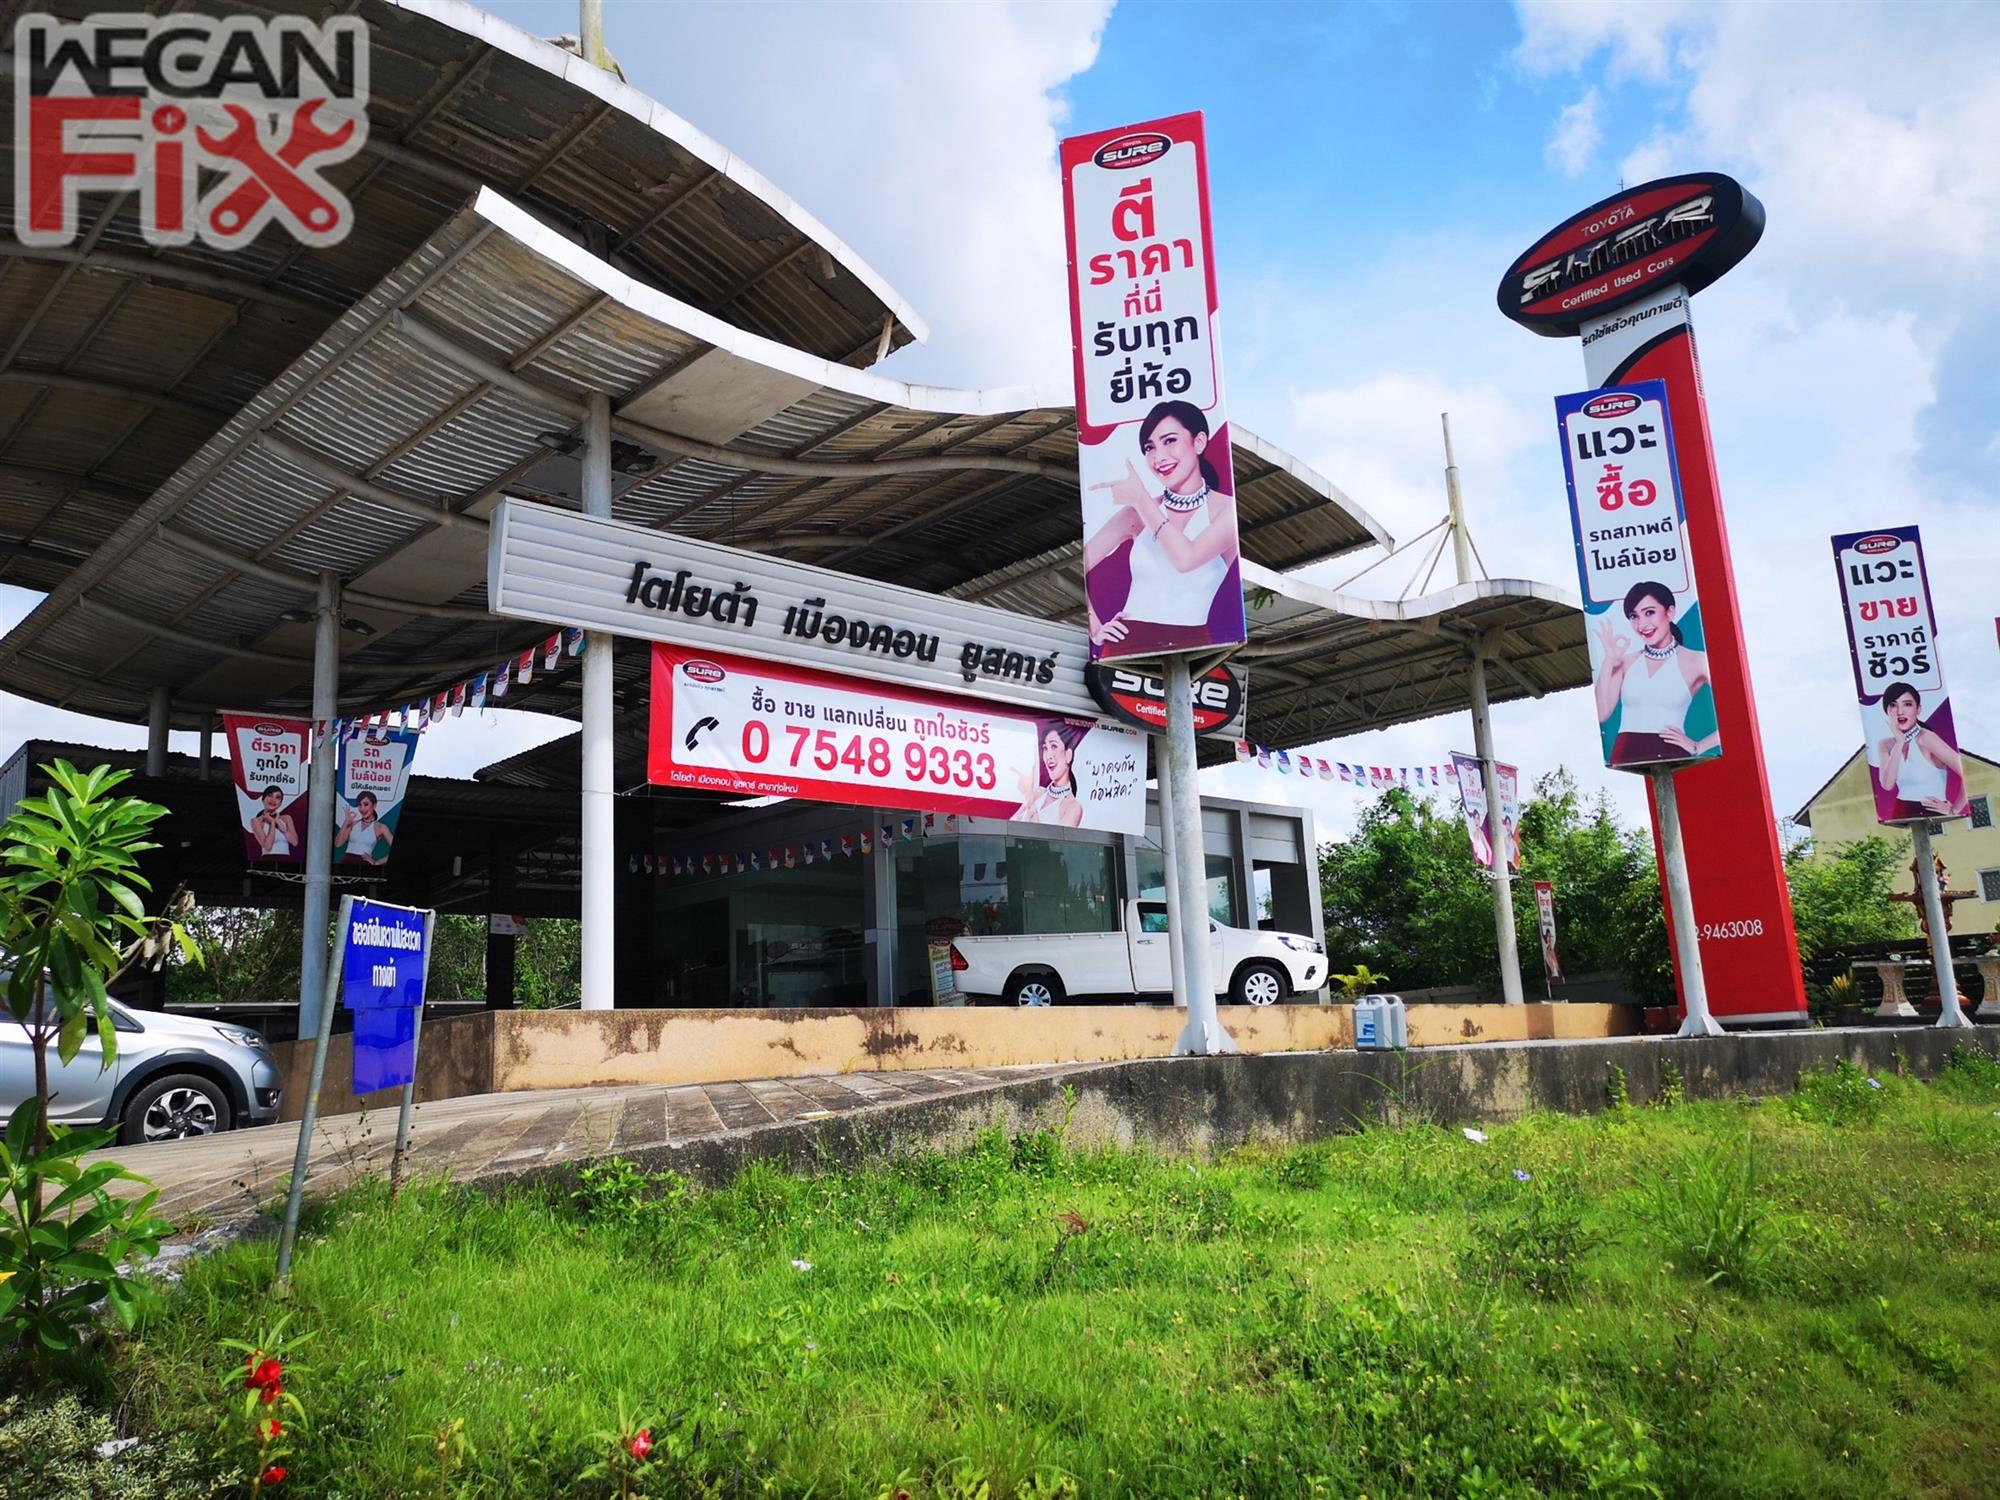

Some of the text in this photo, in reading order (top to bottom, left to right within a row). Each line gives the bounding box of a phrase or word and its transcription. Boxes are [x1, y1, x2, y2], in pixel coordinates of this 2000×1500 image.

[1111, 177, 1156, 242] ตี
[1581, 206, 1636, 237] TOYOTA
[1089, 238, 1195, 286] ราคา
[1123, 280, 1162, 317] ที่นี่
[1561, 256, 1675, 310] Certified Used Cars
[1094, 316, 1199, 357] รับทุก
[1582, 295, 1683, 347] รถใช้แล้วคุณภาพดี
[1110, 357, 1193, 404] ยี่ห้อ
[1577, 424, 1658, 460] แวะ
[1596, 463, 1657, 511] ซื้อ
[1589, 516, 1673, 543] รถสภาพดี
[1591, 546, 1678, 571] ไมล์น้อย
[1850, 559, 1915, 586] แวะ
[625, 562, 1060, 685] โตโยต้า เมืองคอน ยูสคาร์
[1858, 596, 1918, 621] ขาย
[1863, 625, 1926, 649] ราคาดี
[1868, 645, 1931, 679] ชัวร์
[752, 686, 776, 713] ซื้อ
[785, 701, 816, 719] ขาย
[823, 706, 907, 733] แลกเปลี่ยน
[1192, 716, 1205, 724] ars
[251, 737, 296, 755] ตีราคา
[363, 747, 380, 758] รถ
[742, 720, 996, 790] 0 7548 9333
[249, 771, 296, 785] รับทุกยี่ห้อ
[256, 754, 289, 771] ถูกใจ
[350, 768, 392, 783] ไมล์น้อย
[351, 759, 392, 770] สภาพดี
